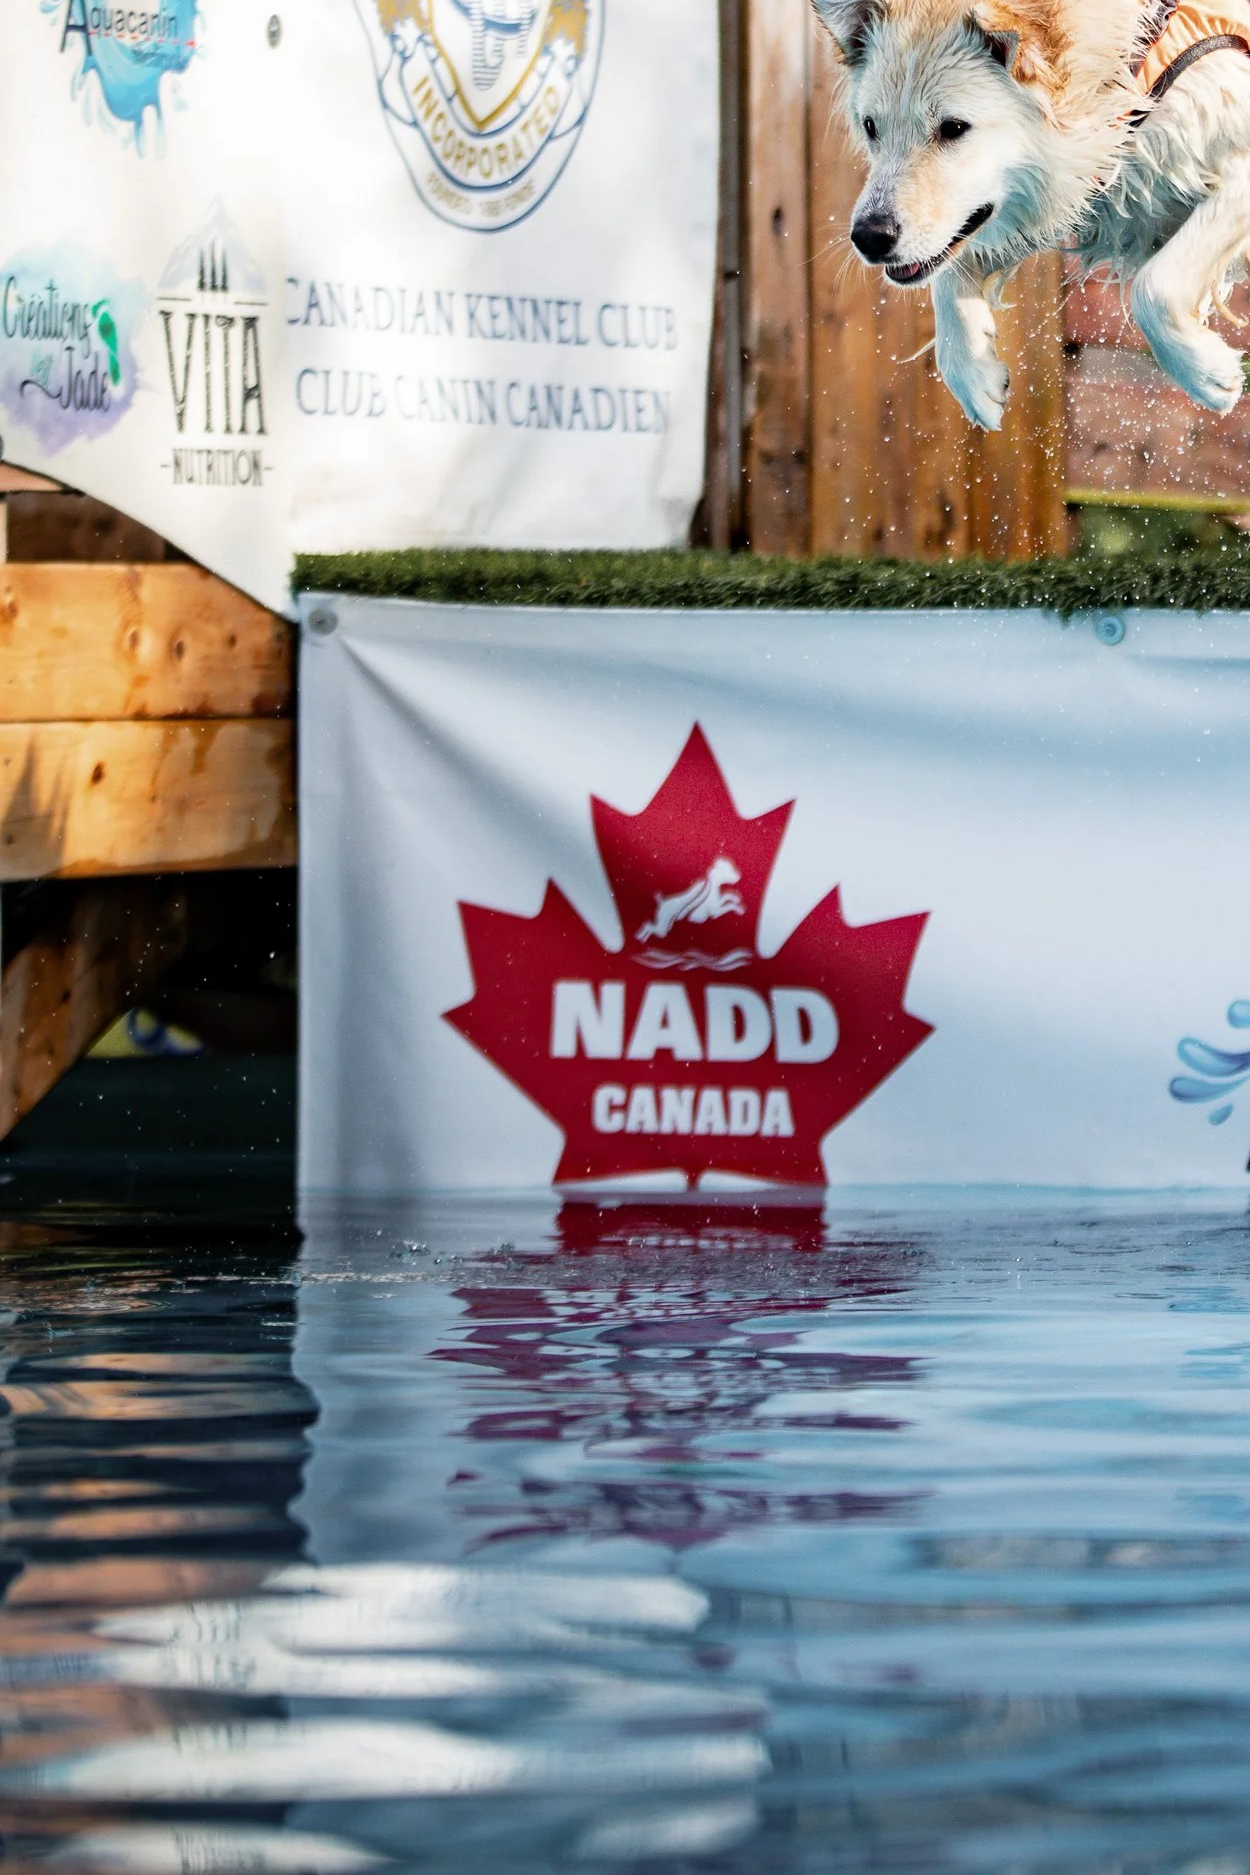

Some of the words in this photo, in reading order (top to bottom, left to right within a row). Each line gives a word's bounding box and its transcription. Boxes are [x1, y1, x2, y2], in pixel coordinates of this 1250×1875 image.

[413, 75, 559, 180] INCORPORATED
[286, 276, 456, 338] CANADIAN
[464, 292, 590, 346] KENNEL
[597, 301, 680, 351] CLUB
[159, 309, 267, 435] VITA
[295, 367, 387, 419] CLUB
[394, 374, 498, 427] CANIN
[505, 380, 672, 435] CANADIEN
[172, 448, 263, 487] NUTRITION
[549, 979, 841, 1065] NADD
[591, 1082, 796, 1138] CANADA
